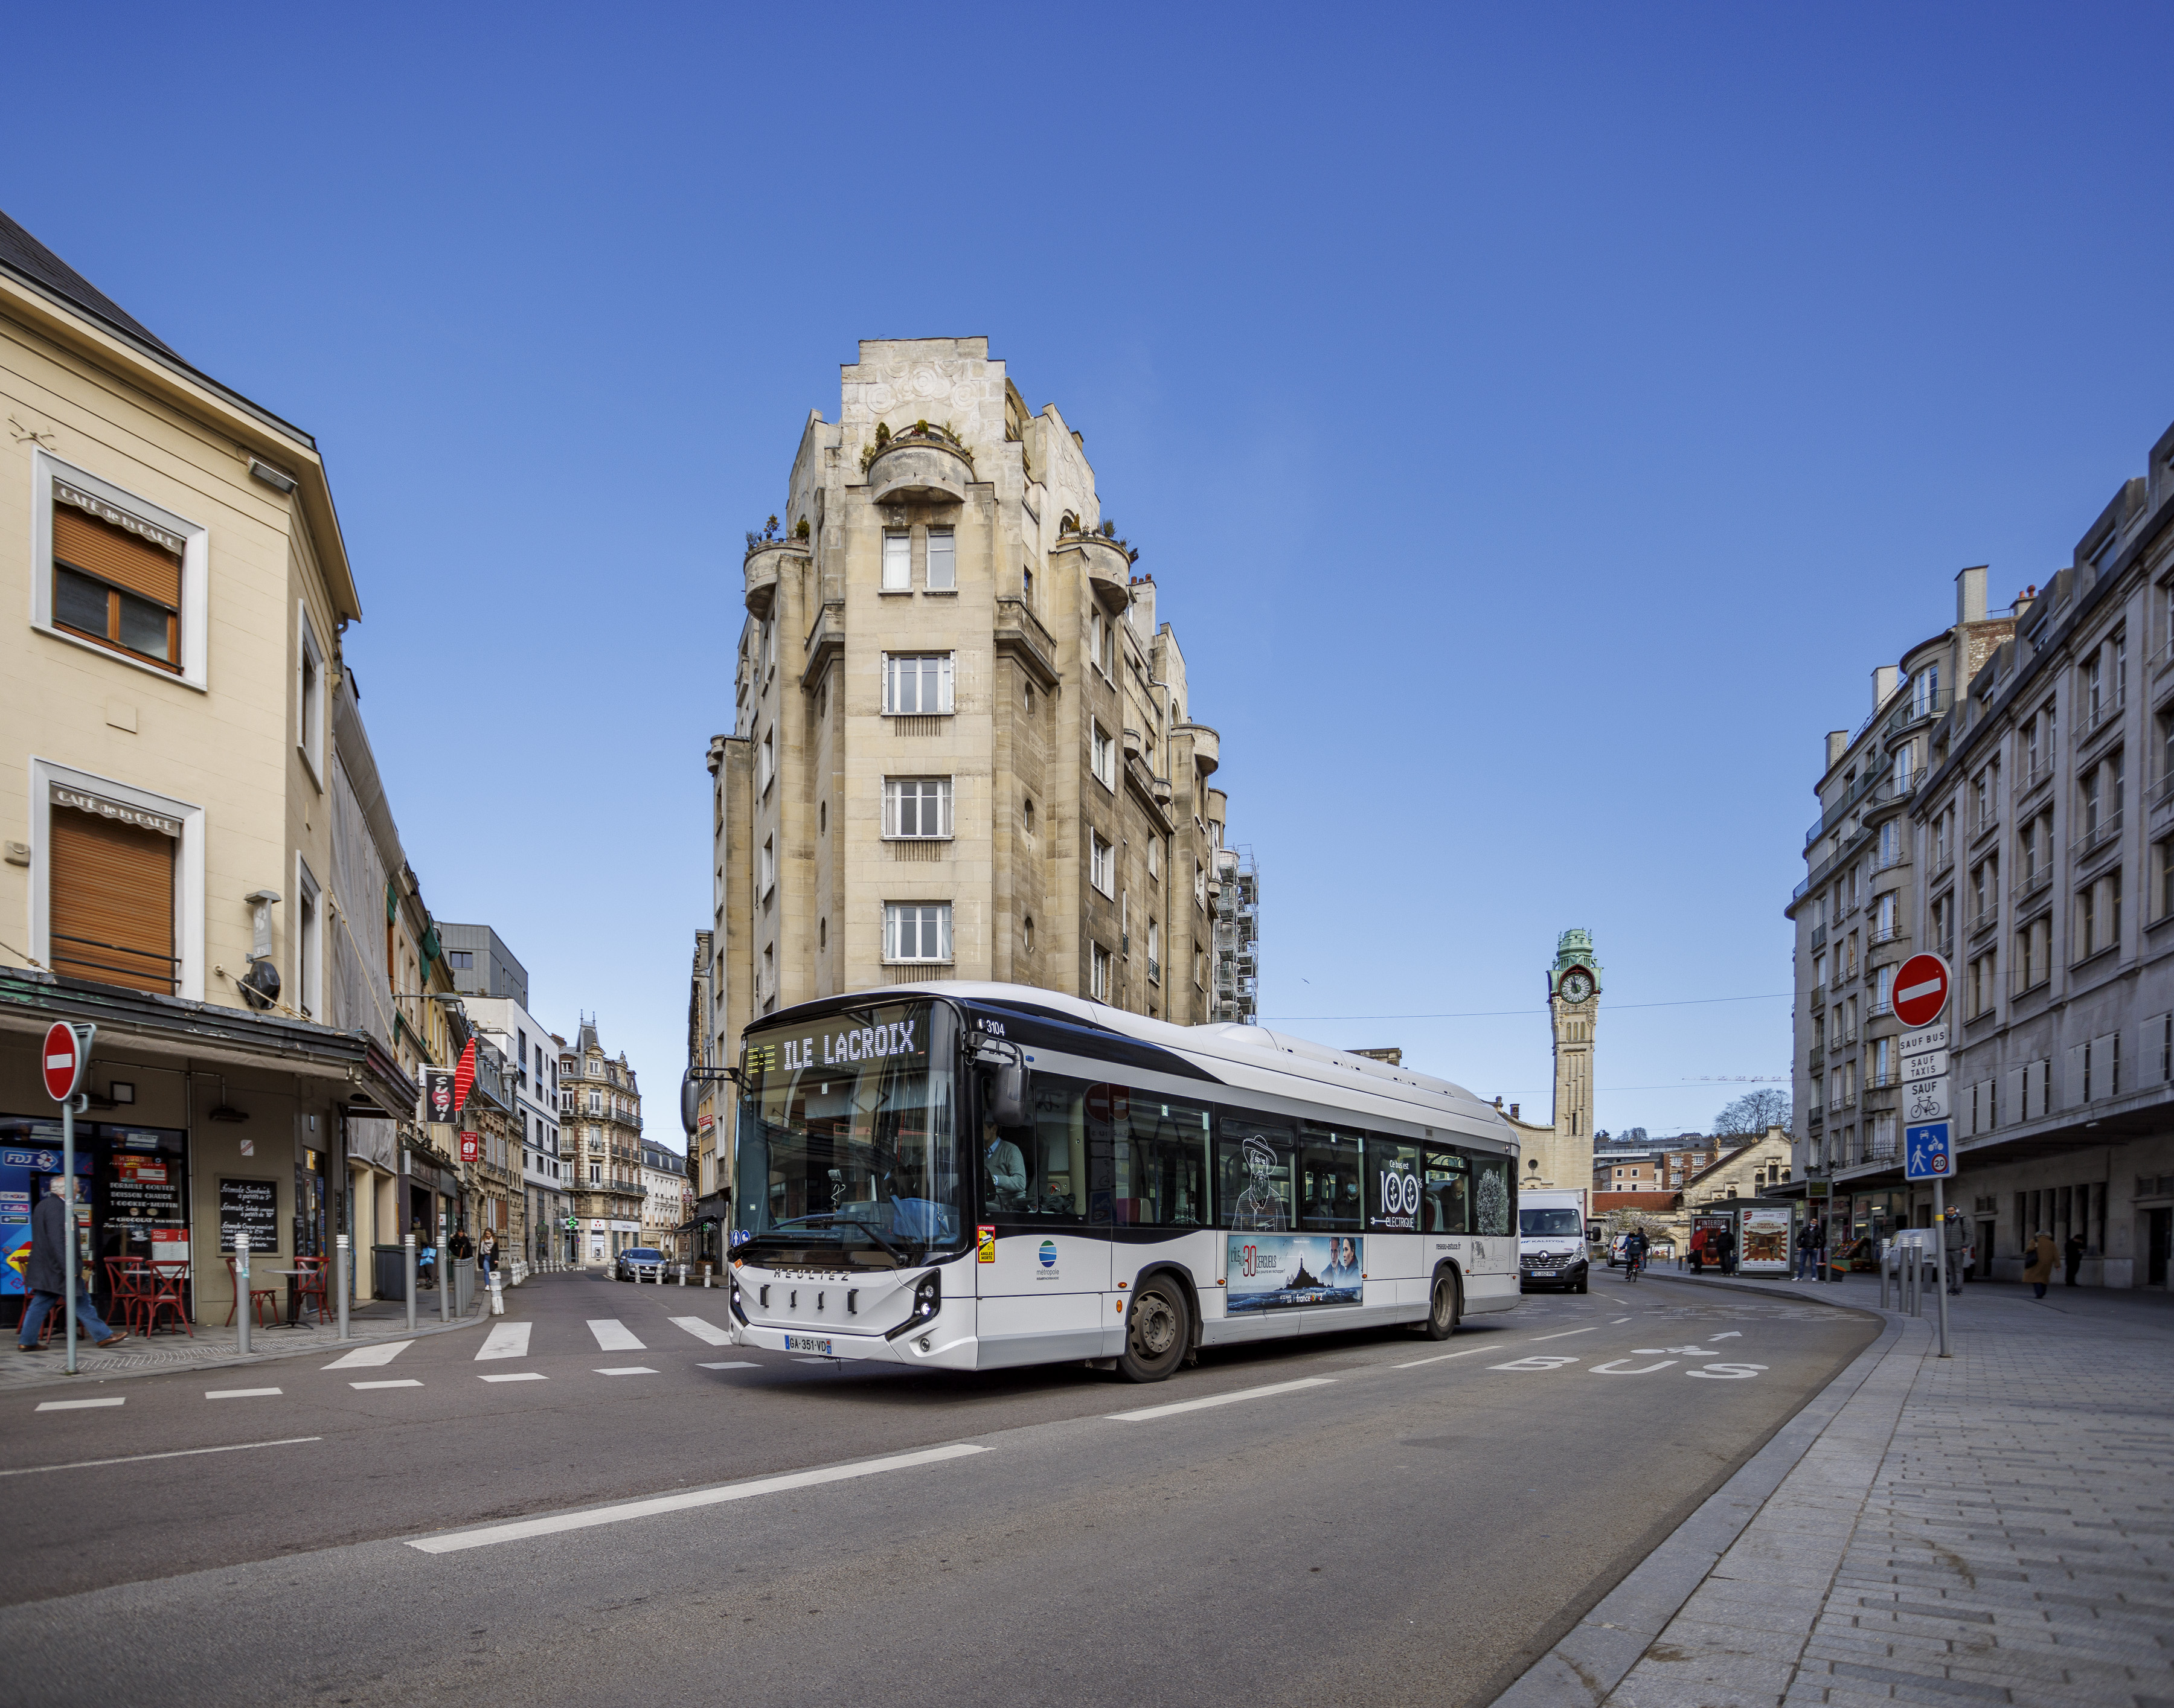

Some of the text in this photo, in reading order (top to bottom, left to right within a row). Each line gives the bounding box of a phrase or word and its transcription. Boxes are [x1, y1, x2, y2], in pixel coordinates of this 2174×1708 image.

[60, 488, 176, 548] CAFÉ de la GARE
[57, 791, 173, 831] CAFÉ de la GARE
[986, 1020, 1005, 1036] 3104
[784, 1038, 813, 1070] ILE
[824, 1020, 914, 1064] LACROIX
[1900, 1032, 1945, 1049] SAUF BUS
[1911, 1056, 1934, 1067] SAUF
[1911, 1066, 1935, 1077] TAXIS
[1912, 1081, 1937, 1095] SAUF
[435, 1076, 449, 1121] SUSHI
[7, 1154, 33, 1163] FDJ
[1935, 1159, 1945, 1168] 20
[1435, 1242, 1461, 1250] reseau-astuce.fr
[1243, 1245, 1257, 1277] 30
[1256, 1255, 1277, 1268] CERCUEILS
[774, 1268, 851, 1281] HEULIEZ
[790, 1338, 826, 1352] GA-351-VD
[1485, 1356, 1769, 1379] BUS
